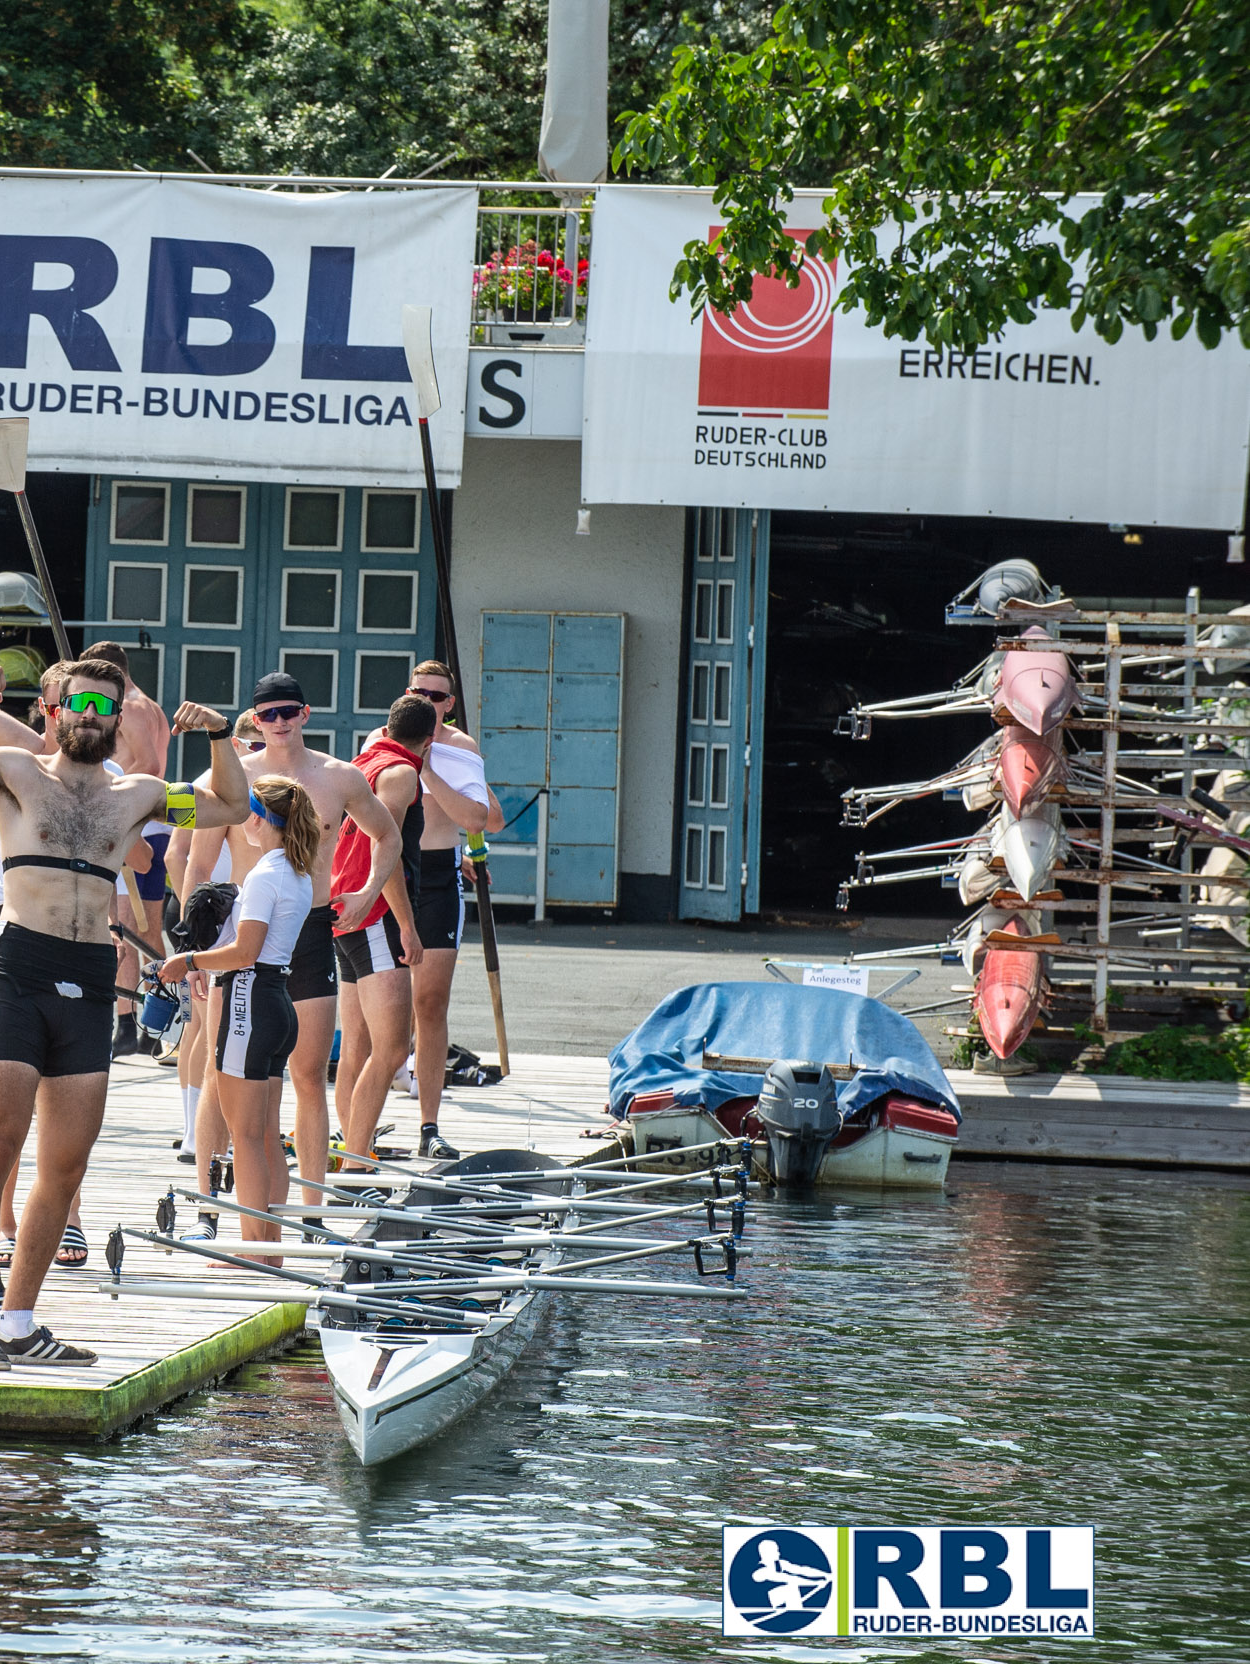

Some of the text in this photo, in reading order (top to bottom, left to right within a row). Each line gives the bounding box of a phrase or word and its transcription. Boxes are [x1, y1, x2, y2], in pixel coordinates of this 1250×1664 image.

[899, 348, 1100, 386] ERREICHEN.
[695, 425, 828, 448] RUDER-CLUB
[694, 449, 827, 470] DEUTSCHLAND
[810, 975, 862, 985] Anlegesteg
[793, 1097, 819, 1109] 20
